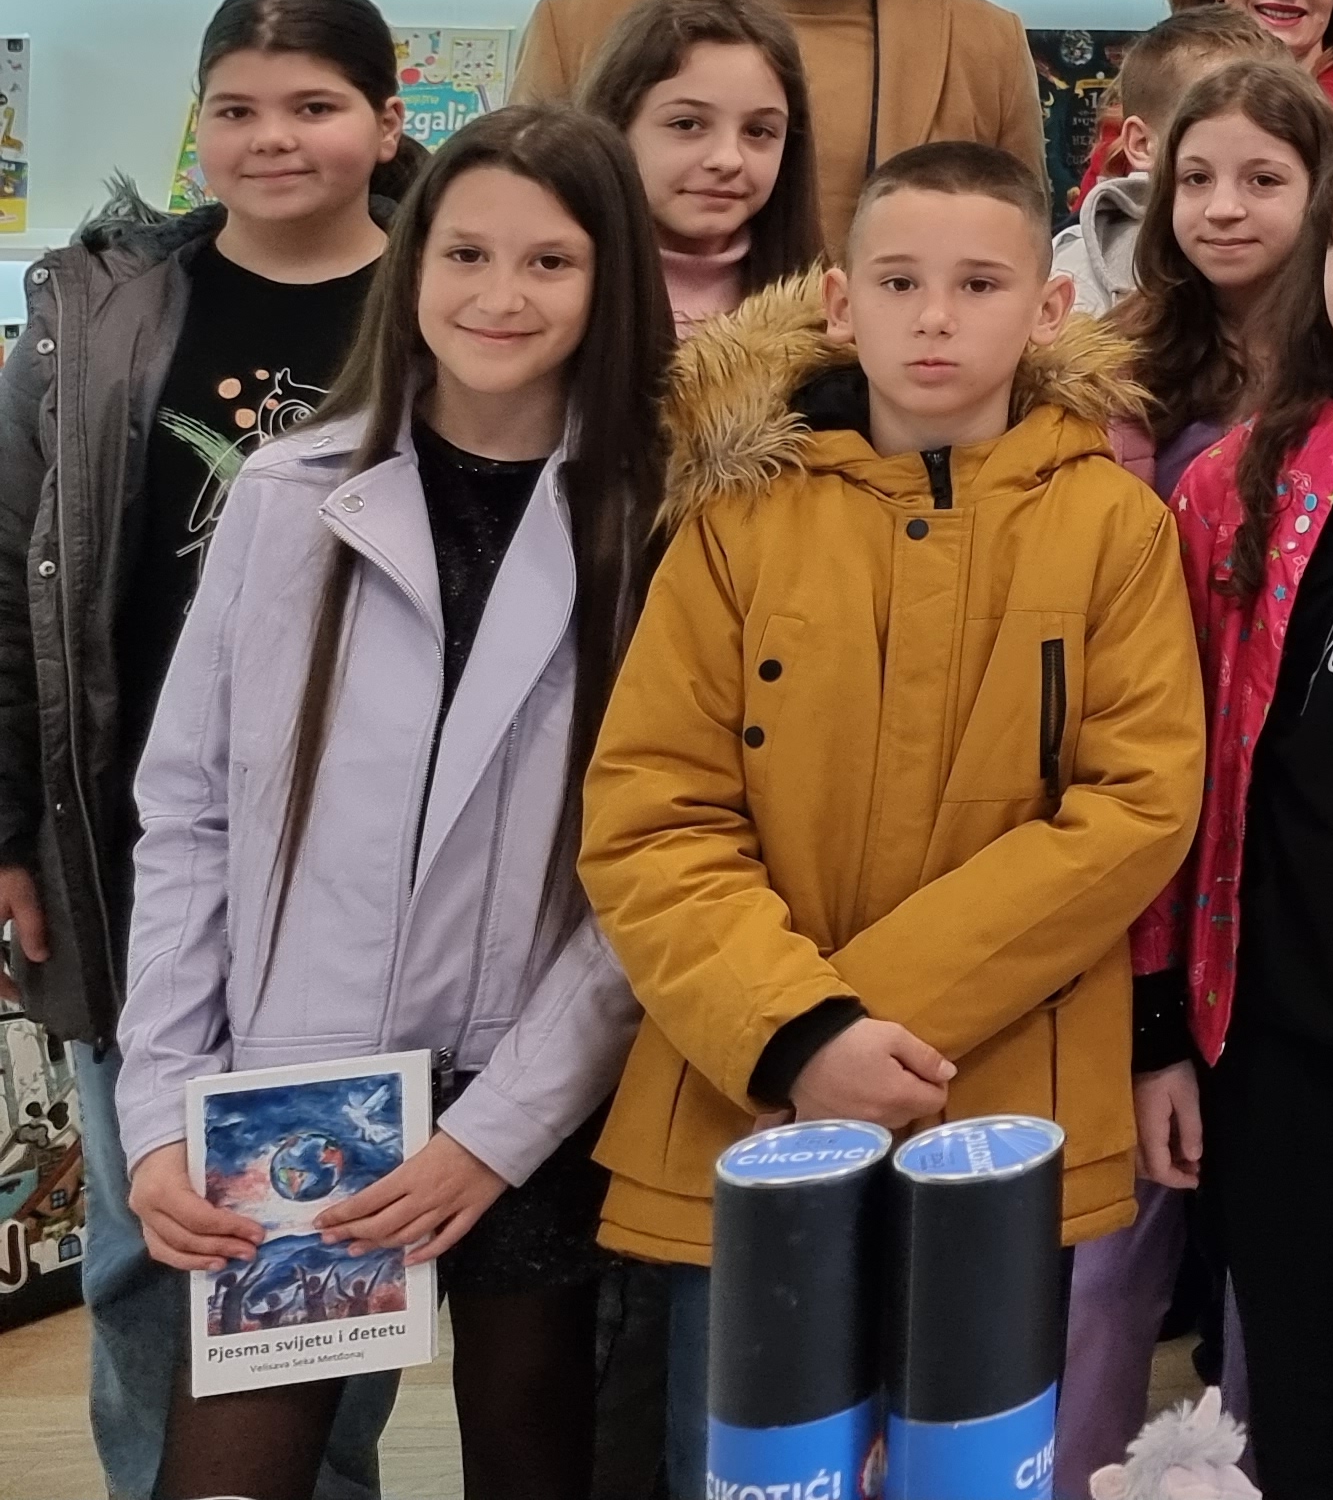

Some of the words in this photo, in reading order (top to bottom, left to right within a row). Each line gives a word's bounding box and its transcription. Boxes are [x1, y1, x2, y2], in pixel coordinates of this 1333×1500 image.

[735, 1147, 877, 1166] CIKOTIĆI
[207, 1342, 271, 1363] Pjesma
[275, 1332, 334, 1353] svijetu
[338, 1331, 344, 1344] i
[348, 1323, 407, 1342] đetetu
